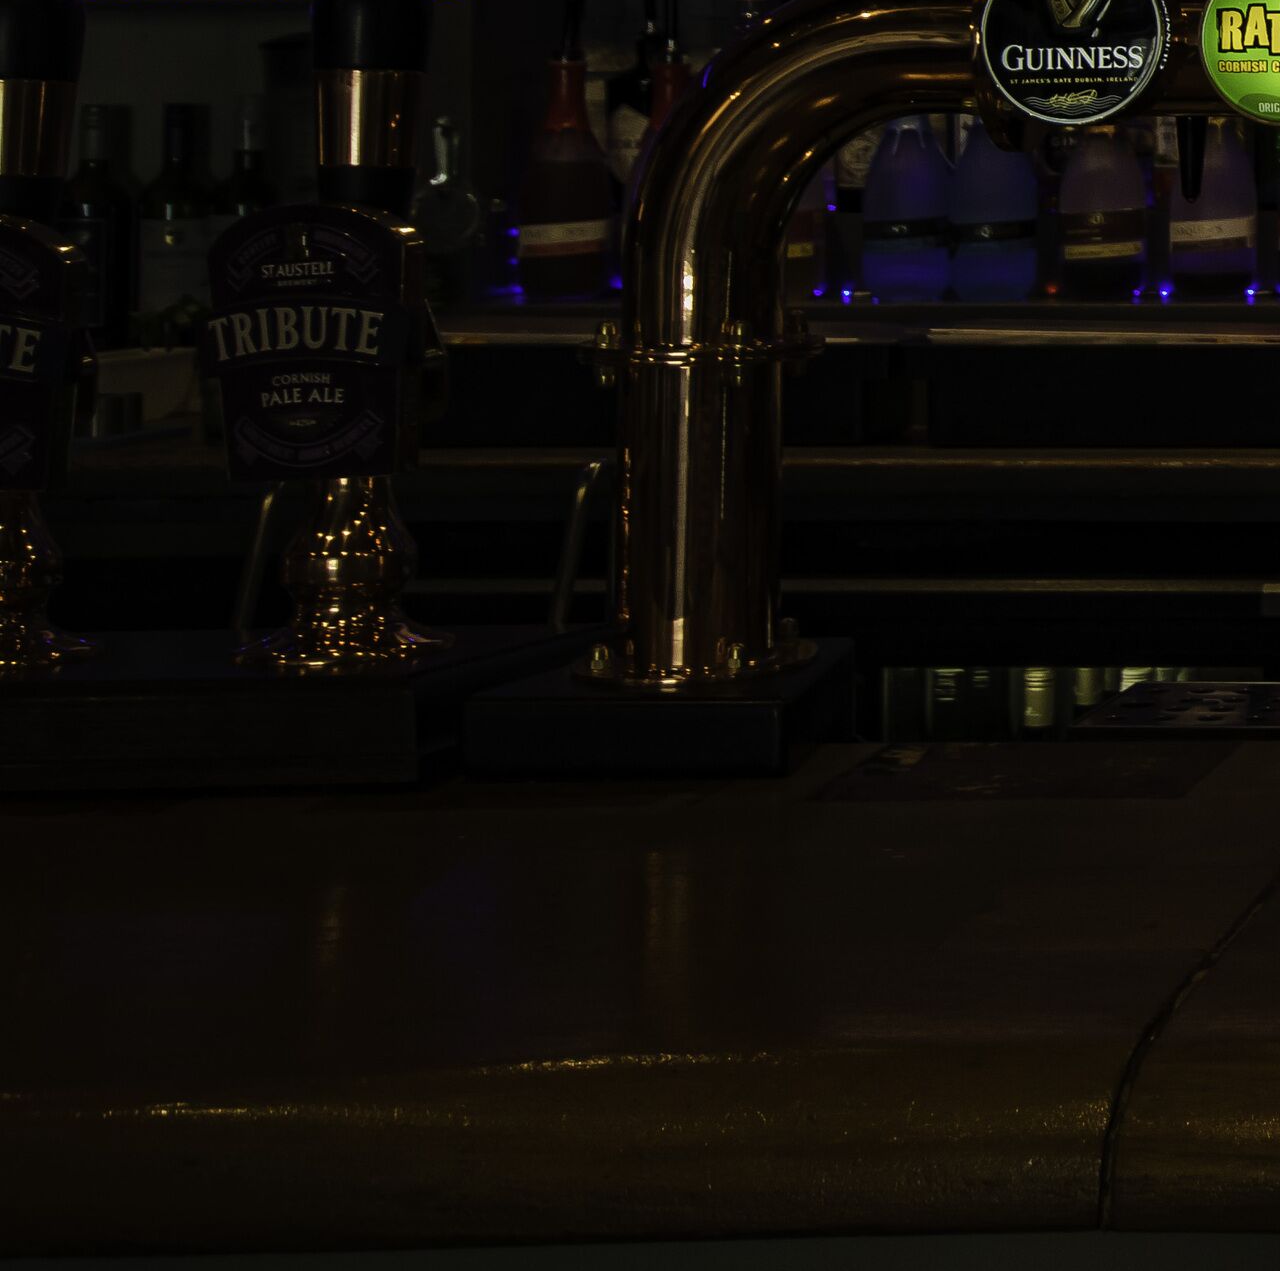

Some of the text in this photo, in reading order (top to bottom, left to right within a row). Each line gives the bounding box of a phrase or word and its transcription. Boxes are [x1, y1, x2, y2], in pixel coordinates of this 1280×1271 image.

[1001, 44, 1144, 71] GUINNESS
[1218, 59, 1268, 73] CORNISH
[275, 261, 335, 277] AUSTELL
[208, 305, 385, 362] TRIBUTE
[272, 372, 331, 387] CORNISH
[260, 386, 345, 408] PALE ALE
